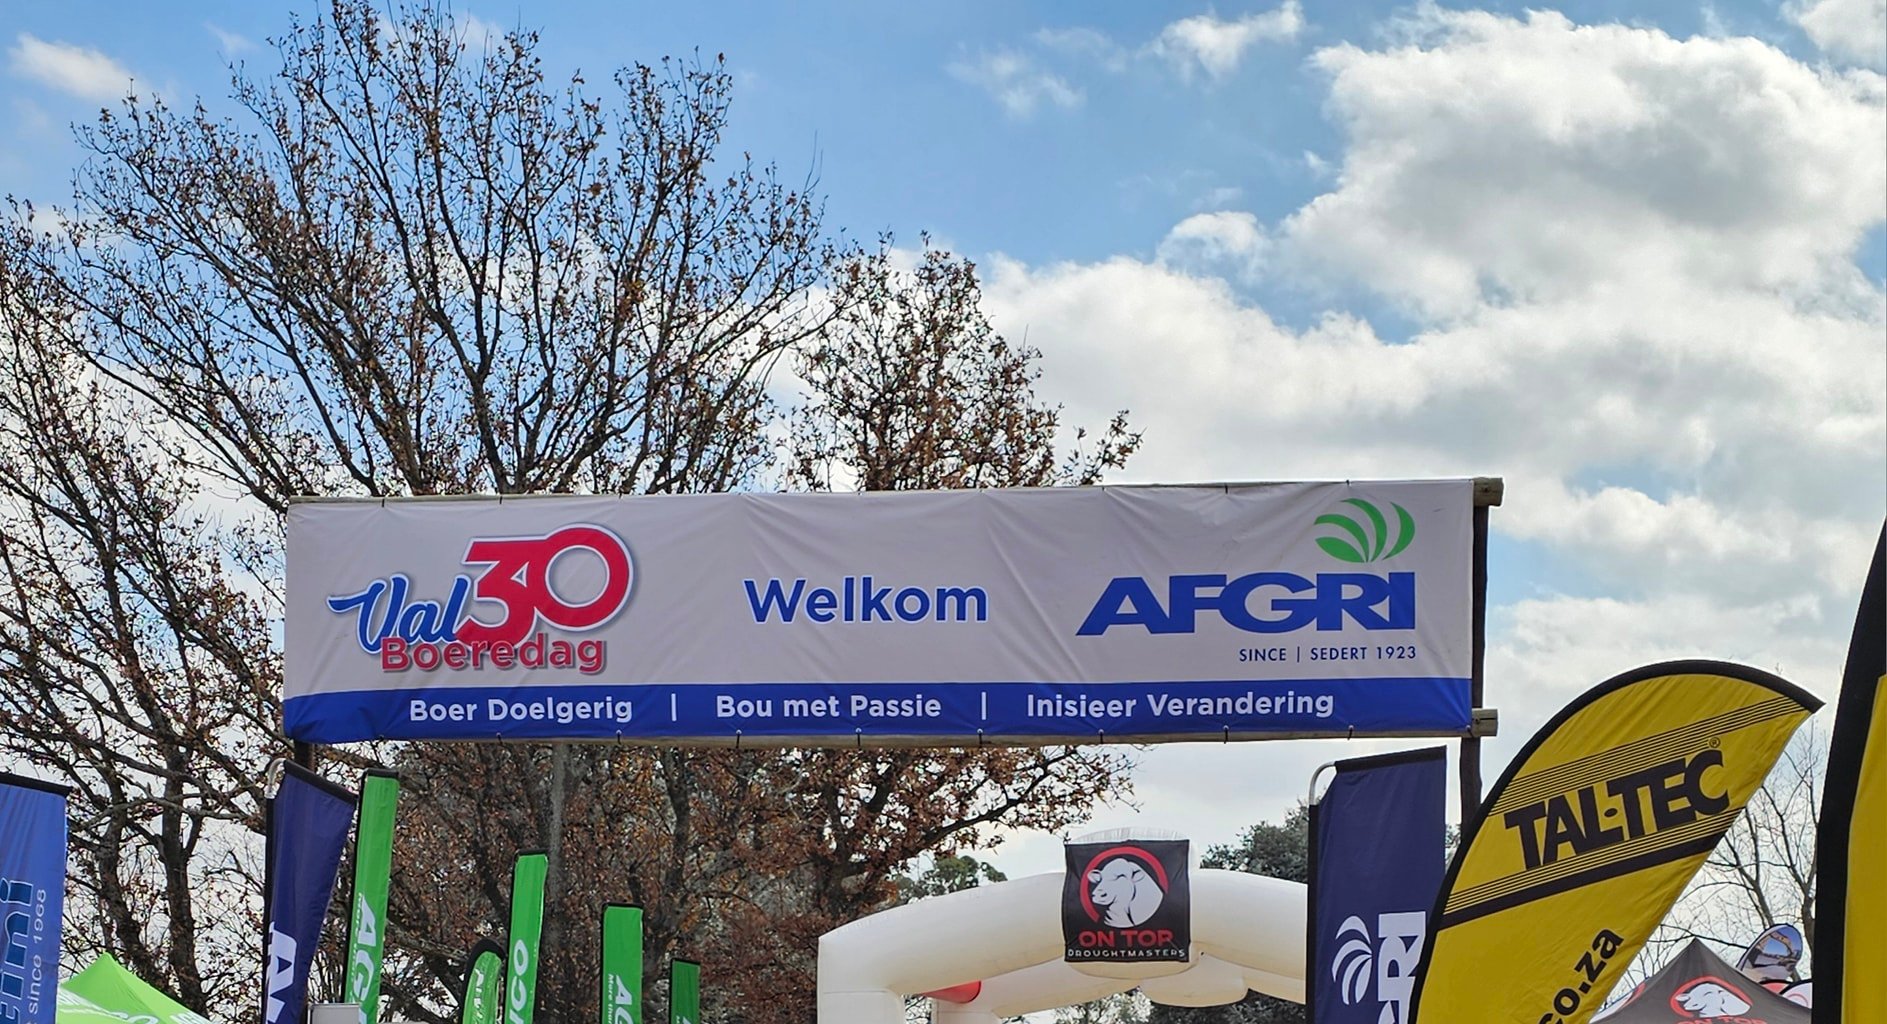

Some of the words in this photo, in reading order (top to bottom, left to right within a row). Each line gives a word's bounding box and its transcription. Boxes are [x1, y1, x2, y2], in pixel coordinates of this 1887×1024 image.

[328, 574, 470, 653] Val
[457, 522, 635, 648] 30
[744, 576, 988, 624] Welkom
[1076, 571, 1416, 636] AFGRI
[381, 632, 607, 674] Boeredag
[1239, 648, 1287, 663] SINCE
[1310, 647, 1368, 662] SEDERT
[1376, 645, 1417, 661] 1923
[409, 699, 478, 722] Boer
[487, 697, 633, 724] Doelgerig
[716, 696, 775, 718] Bou
[783, 698, 842, 719] met
[851, 694, 942, 718] Passie
[1027, 693, 1137, 718] Inisieer
[1147, 690, 1335, 717] Verandering
[33, 888, 47, 945] 1968
[1078, 930, 1115, 948] ON
[1120, 929, 1174, 948] TOP
[1067, 948, 1186, 958] DROUGHTMASTERS
[27, 953, 42, 1011] since
